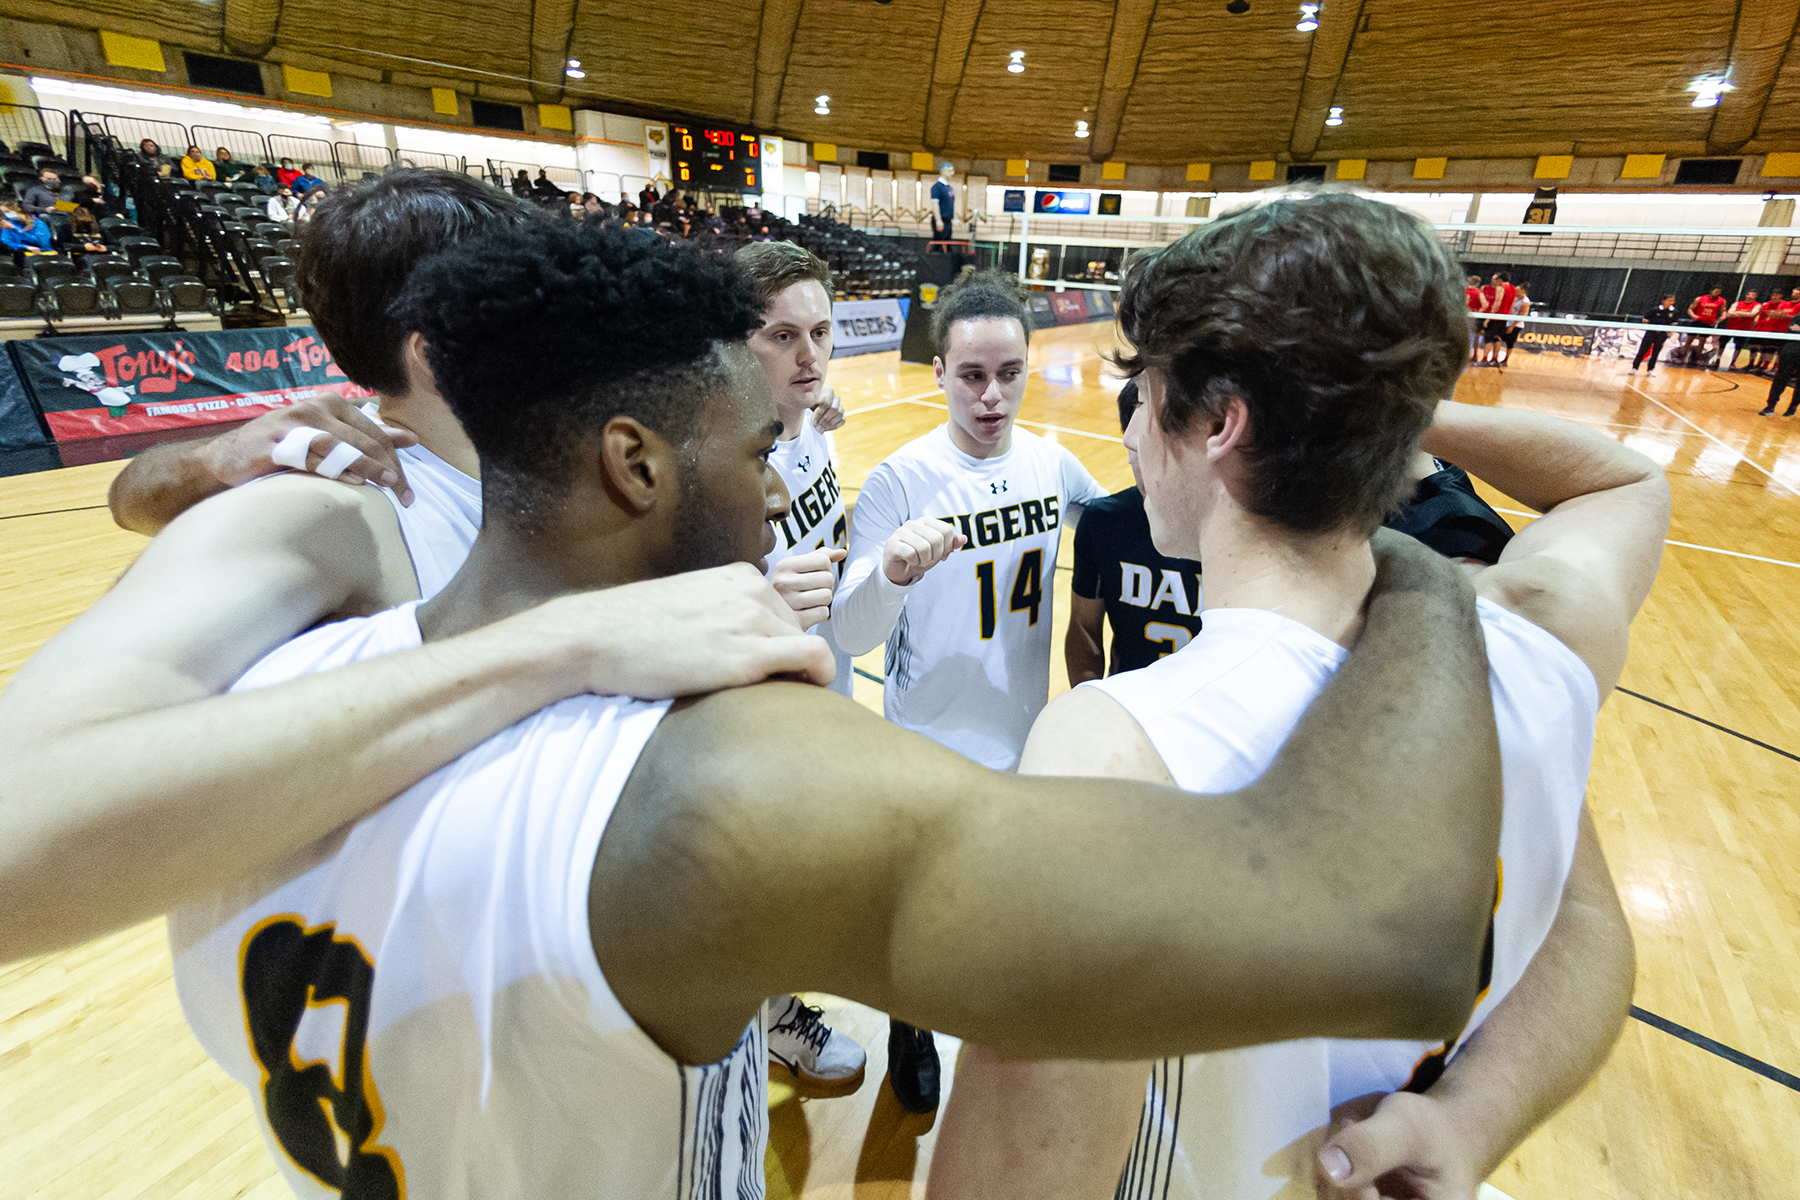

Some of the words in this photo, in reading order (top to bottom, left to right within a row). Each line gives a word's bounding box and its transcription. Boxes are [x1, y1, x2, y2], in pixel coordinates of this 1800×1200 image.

[682, 134, 693, 151] 0
[704, 129, 735, 147] 4:00
[729, 149, 735, 161] 1
[748, 143, 759, 158] 0
[680, 167, 690, 181] 0
[746, 173, 755, 186] 0
[837, 316, 897, 338] TIGERS
[1517, 332, 1585, 347] LOUNGE
[95, 340, 196, 394] Tony's
[145, 403, 197, 417] FAMOUS
[196, 399, 230, 412] PIZZA
[975, 547, 1043, 641] 14
